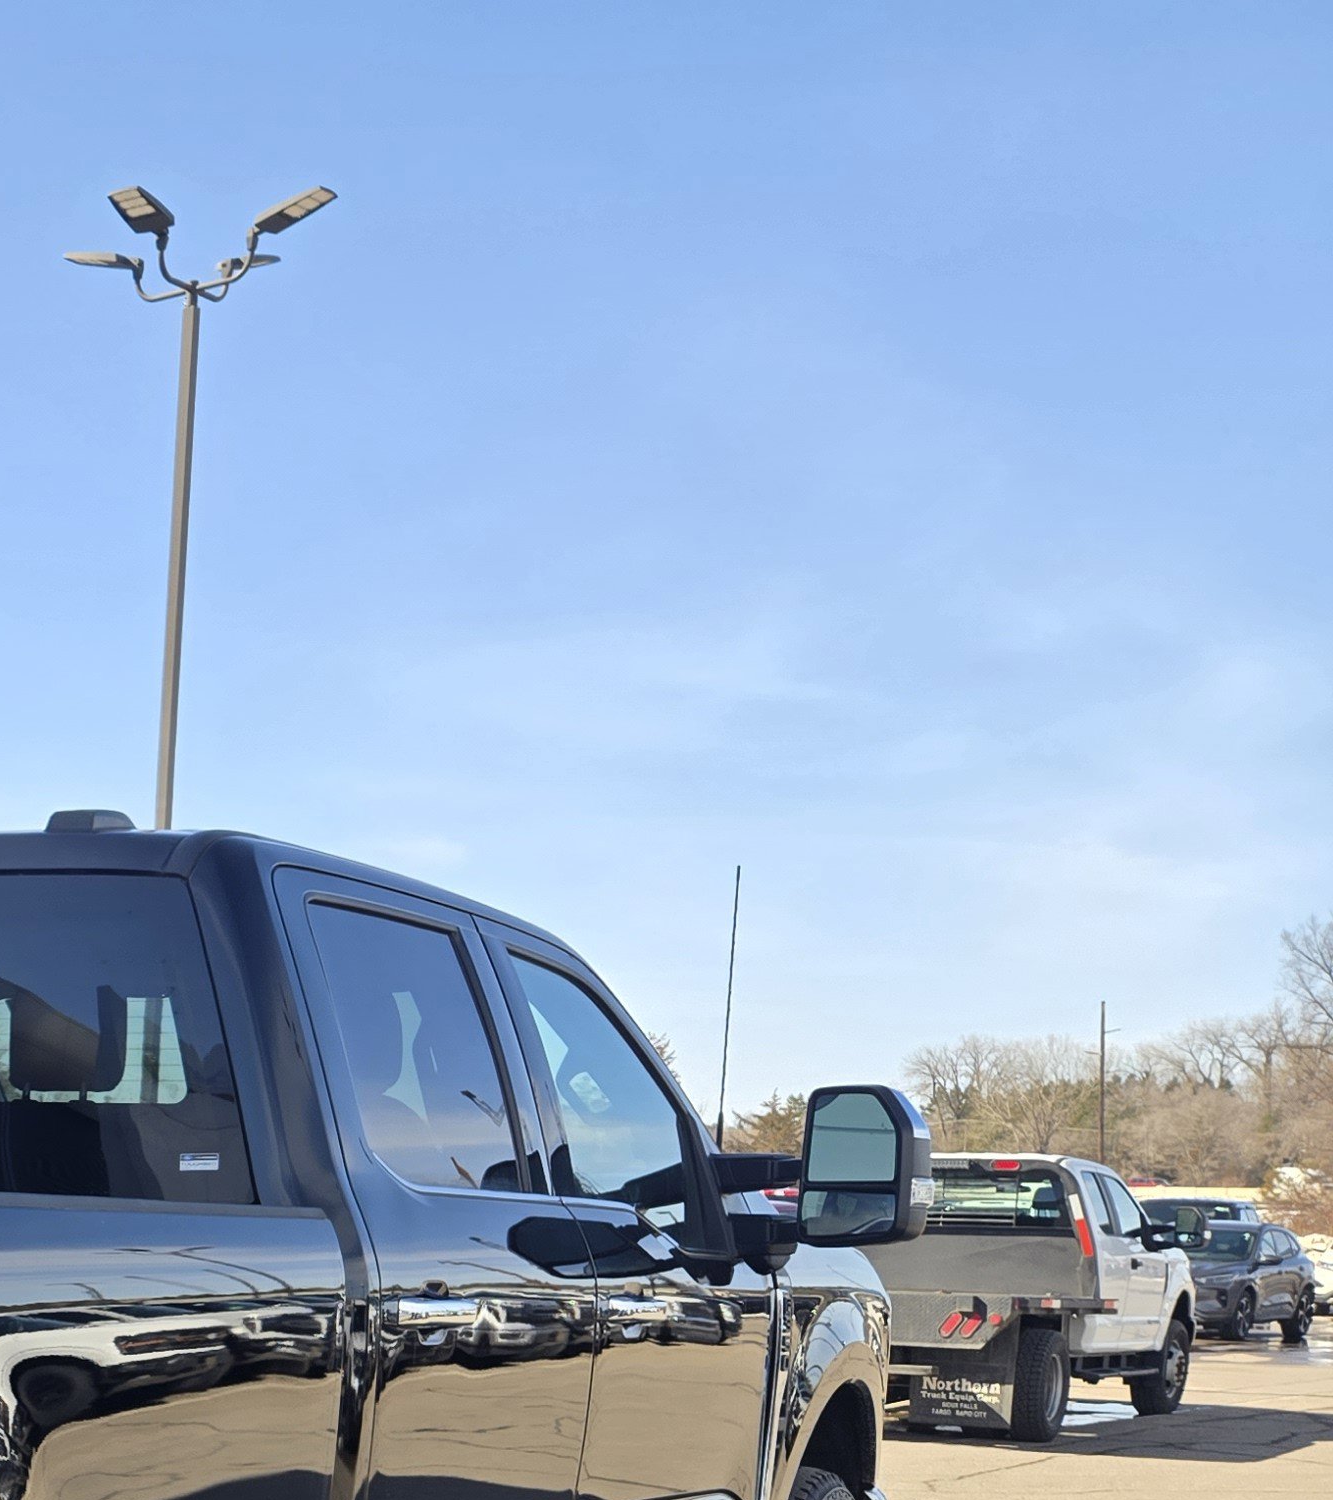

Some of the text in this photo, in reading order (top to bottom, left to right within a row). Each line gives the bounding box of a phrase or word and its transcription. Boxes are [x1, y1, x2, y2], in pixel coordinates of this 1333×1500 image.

[921, 1376, 1001, 1395] Northern
[920, 1390, 947, 1400] Truck
[959, 1402, 978, 1410] FALLS
